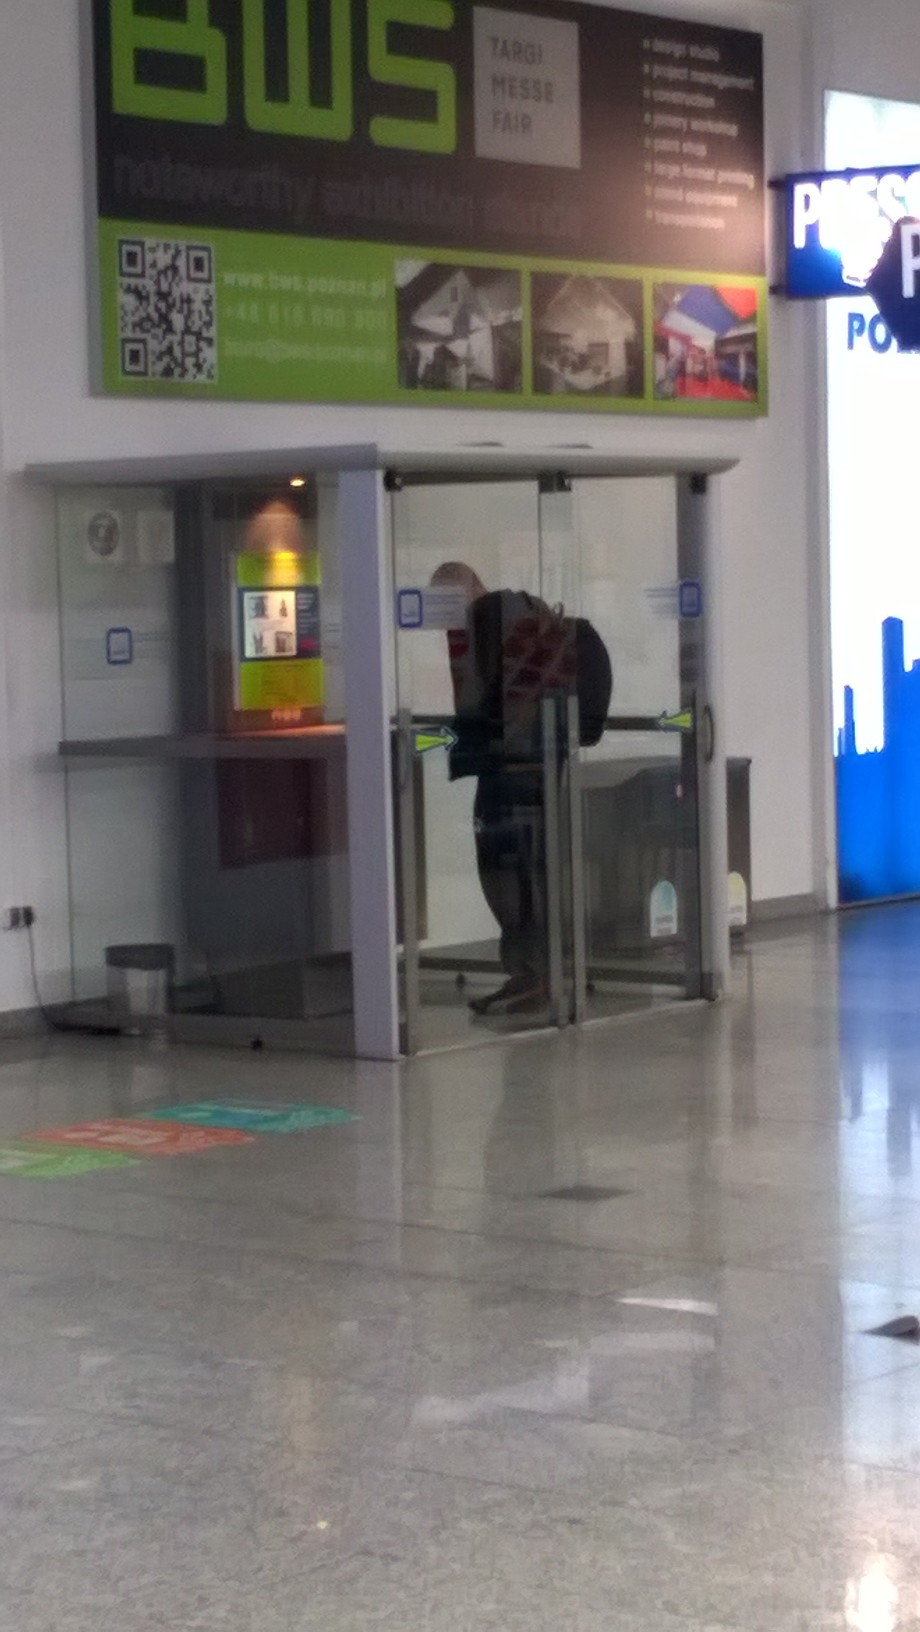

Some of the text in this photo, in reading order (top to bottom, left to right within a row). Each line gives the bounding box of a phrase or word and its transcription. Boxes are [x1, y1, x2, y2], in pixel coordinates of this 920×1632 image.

[490, 36, 543, 65] TARGI
[491, 74, 555, 104] MESSE
[492, 110, 534, 137] FAIR
